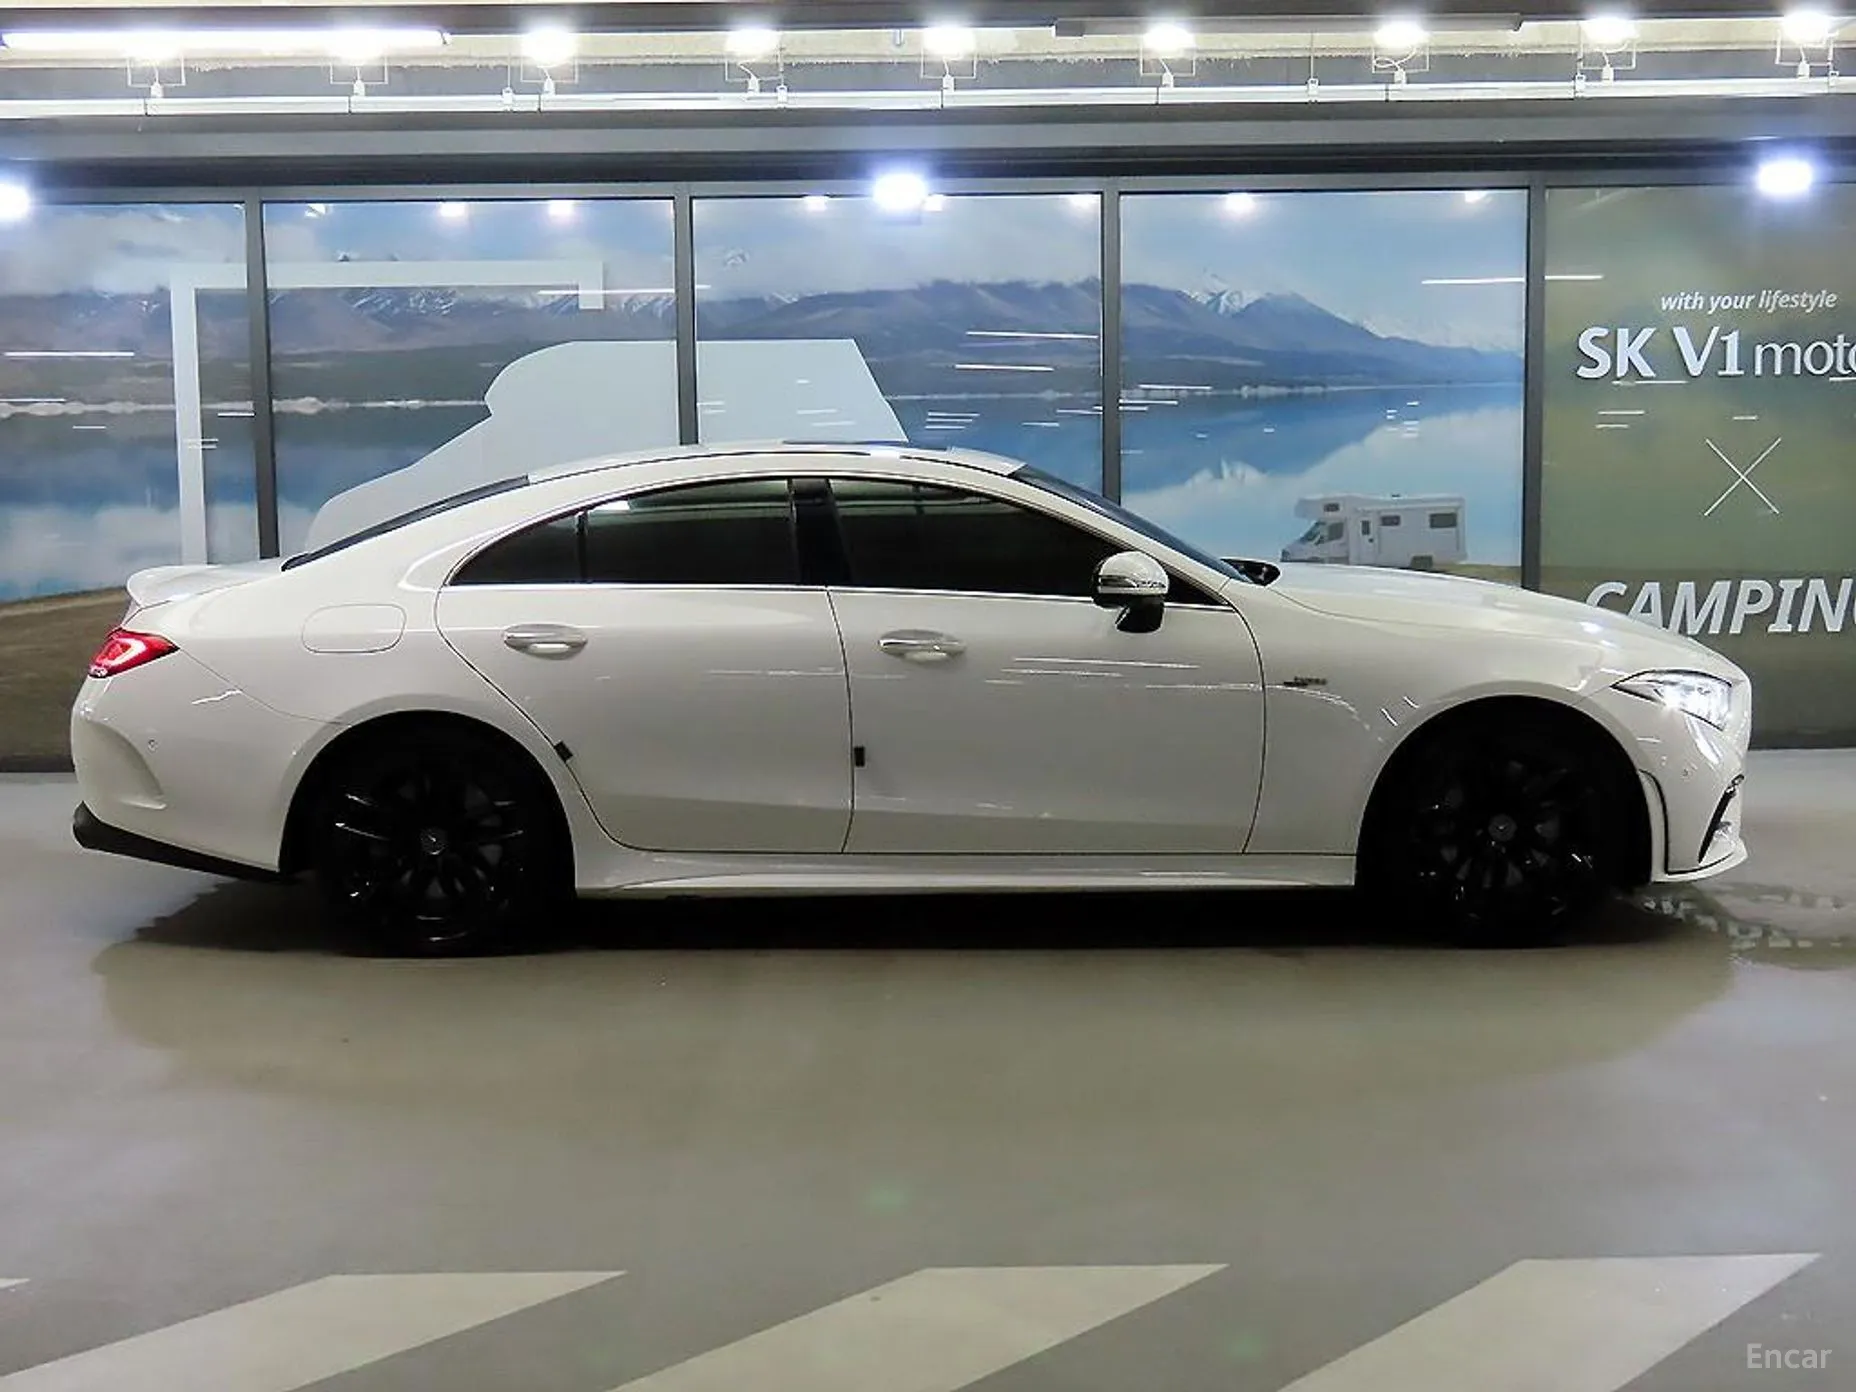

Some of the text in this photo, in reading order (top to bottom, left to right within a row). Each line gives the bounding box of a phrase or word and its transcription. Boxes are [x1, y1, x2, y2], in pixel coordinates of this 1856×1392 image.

[1661, 289, 1838, 315] with your lifestyle
[1576, 326, 1656, 379] SK
[1754, 333, 1856, 376] mot
[1586, 578, 1856, 635] AMPIN
